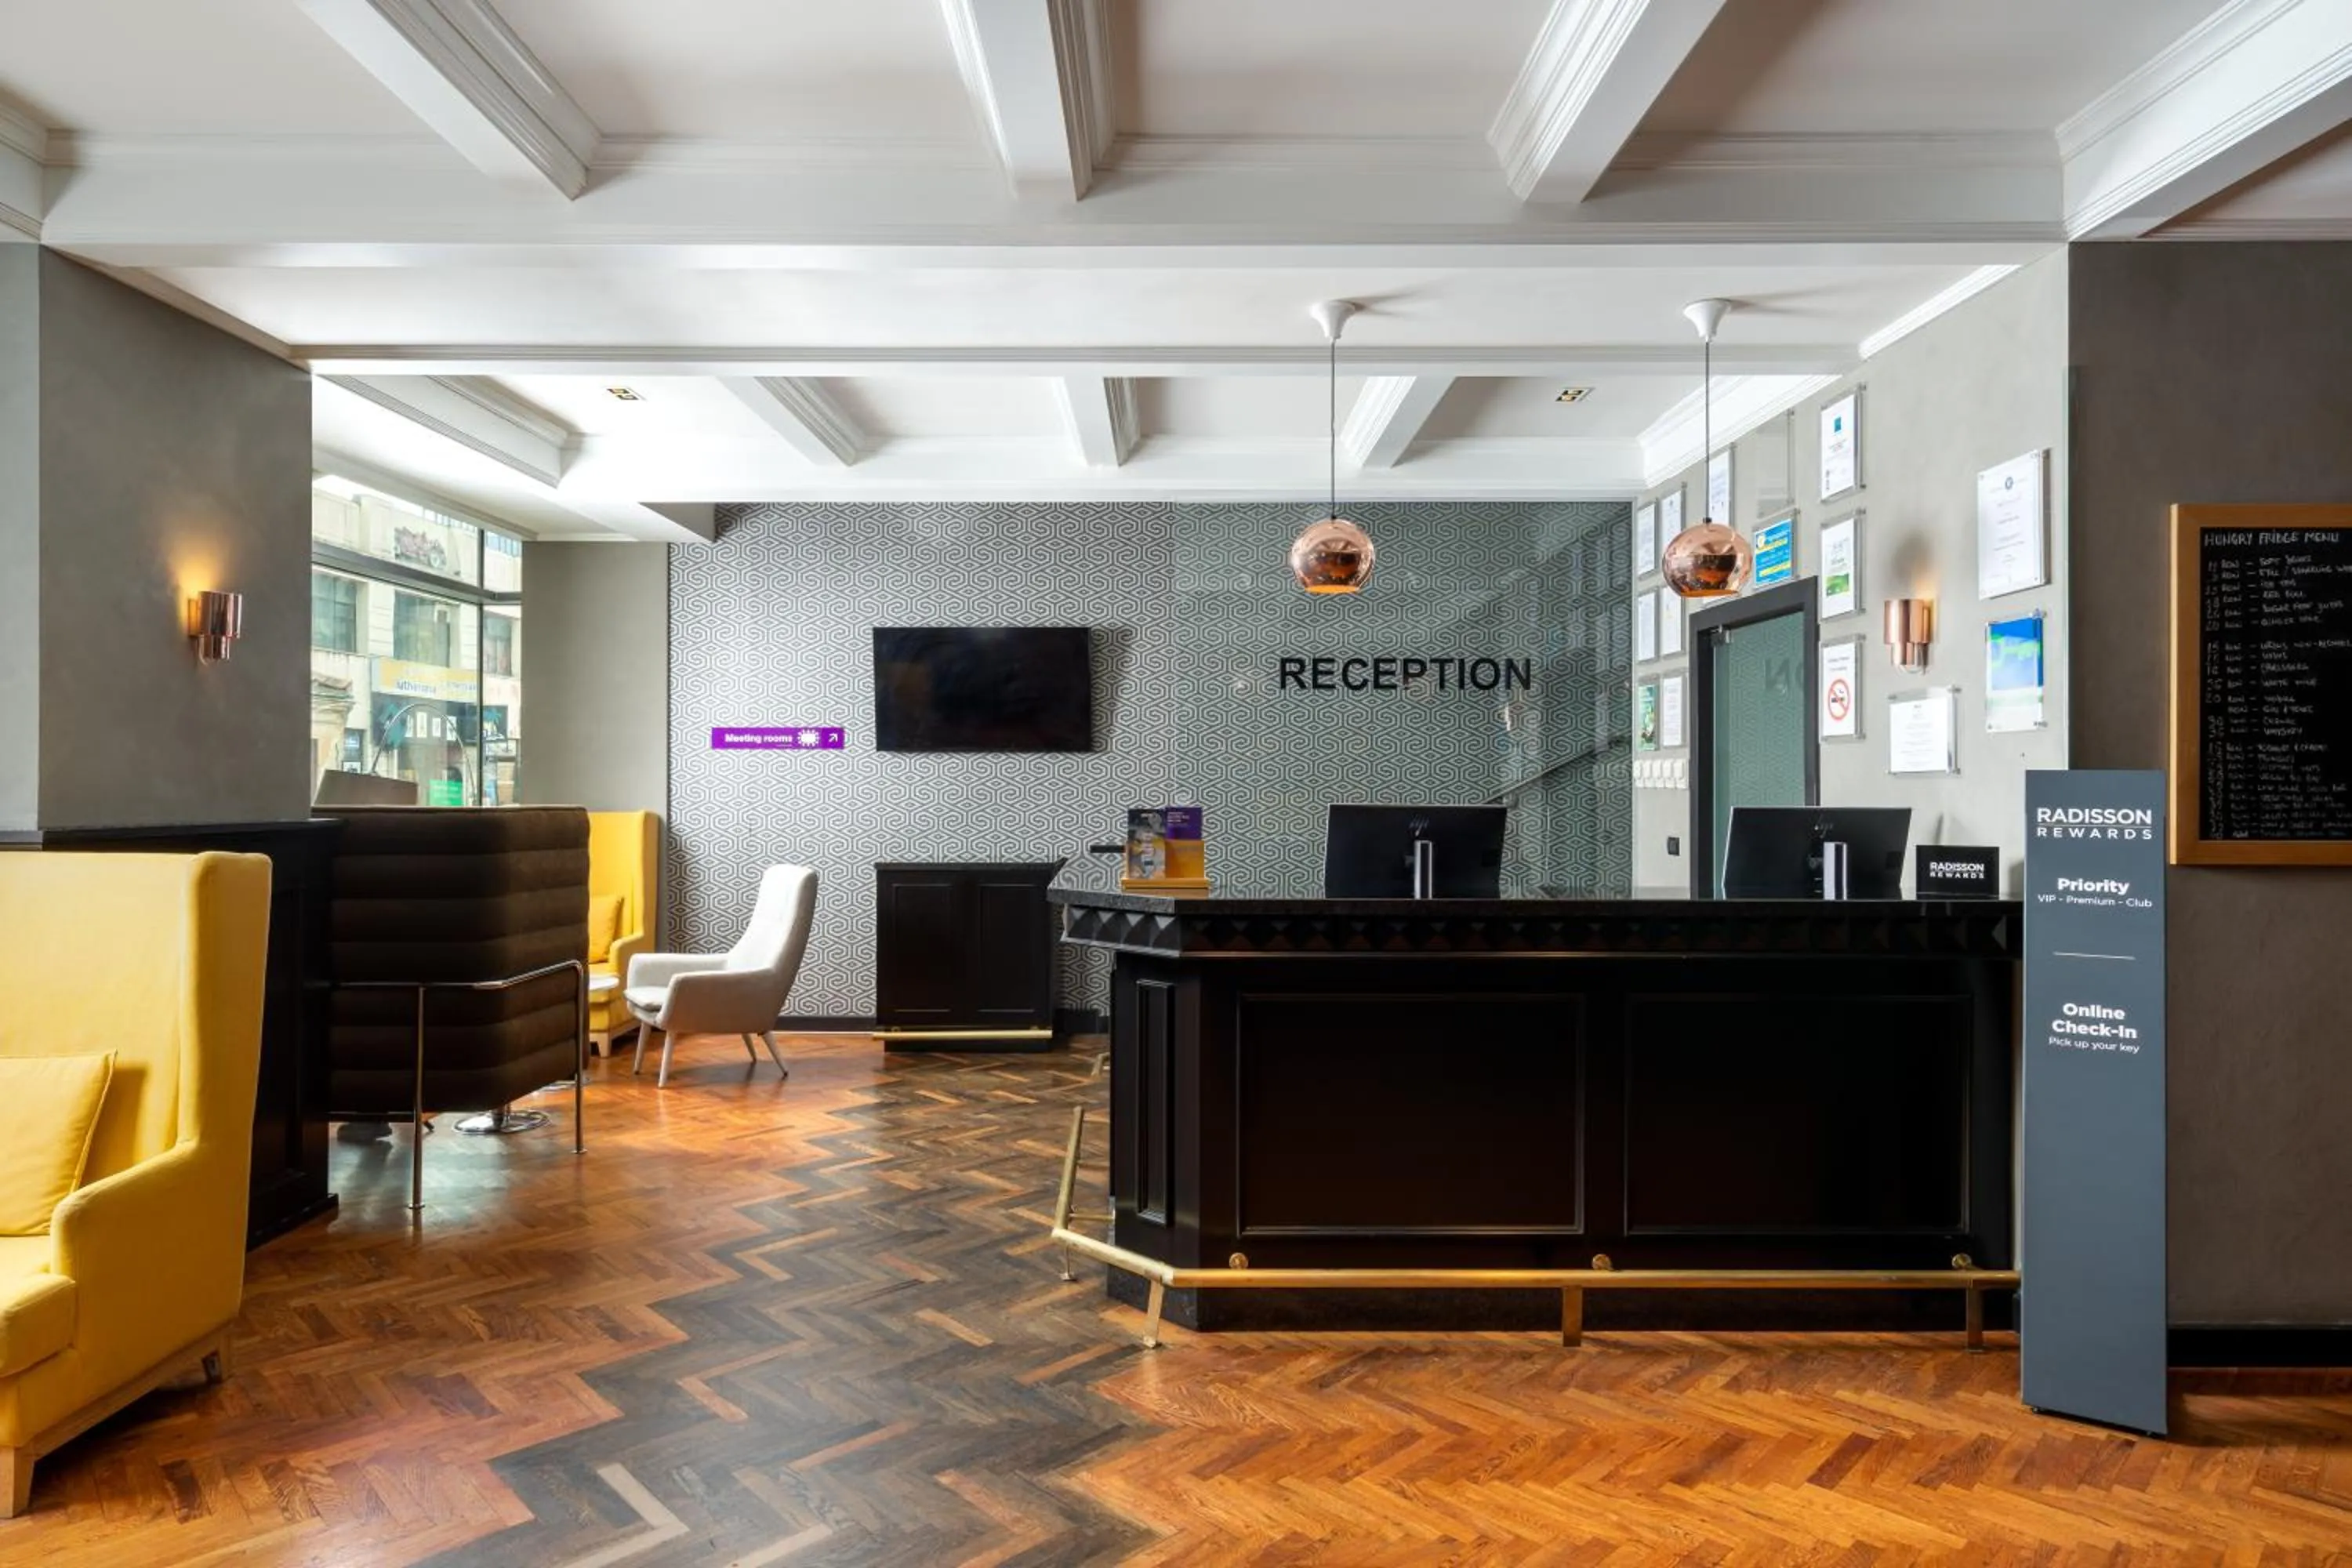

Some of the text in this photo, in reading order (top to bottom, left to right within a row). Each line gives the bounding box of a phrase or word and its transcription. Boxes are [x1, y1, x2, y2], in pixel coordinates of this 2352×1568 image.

[2204, 532, 2339, 546] HUNGRY FRIDGE MENU
[1279, 658, 1530, 691] RECEPTION
[724, 733, 793, 744] Meeting rooms
[2037, 808, 2152, 825] RADISSON
[2037, 827, 2152, 840] REWARDS
[1929, 862, 1984, 872] RADISSON
[2057, 877, 2130, 896] Priority
[2038, 895, 2056, 903] VIP
[2066, 895, 2115, 906] Premium
[2125, 898, 2152, 907] Club
[2062, 1003, 2125, 1020] Online
[2049, 1036, 2140, 1054] Pick up your key
